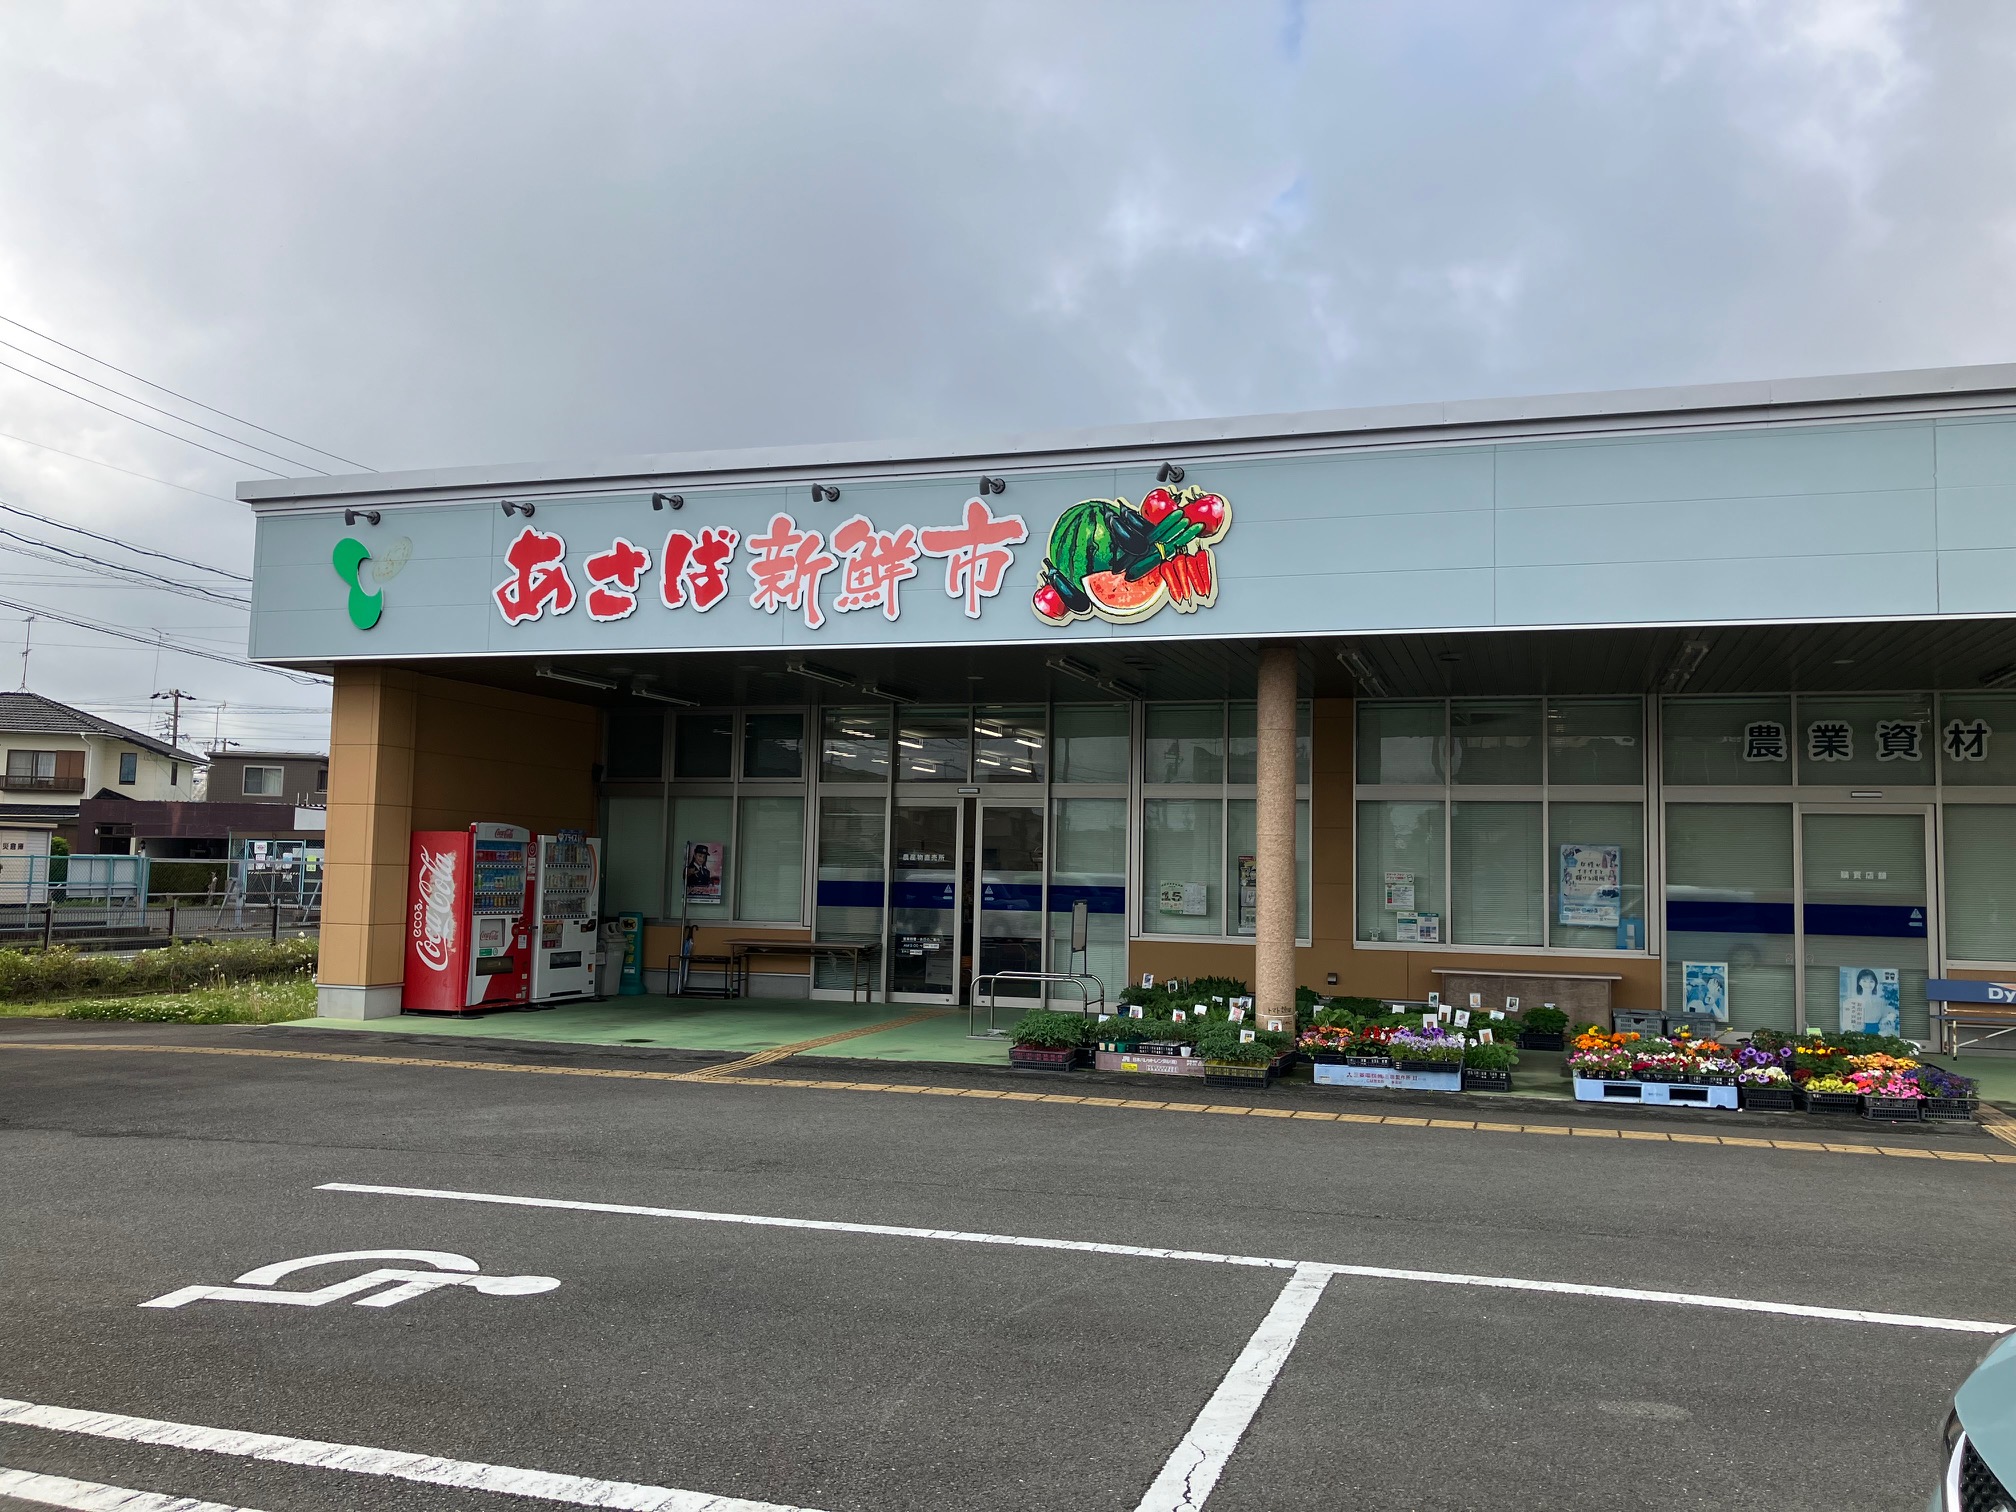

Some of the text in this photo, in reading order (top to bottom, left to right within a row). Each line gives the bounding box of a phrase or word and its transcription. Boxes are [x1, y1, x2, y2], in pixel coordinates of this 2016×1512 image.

[492, 497, 1028, 631] あさば新鮮市
[1744, 719, 1991, 762] 農業資材
[416, 844, 453, 972] Coca-Cola
